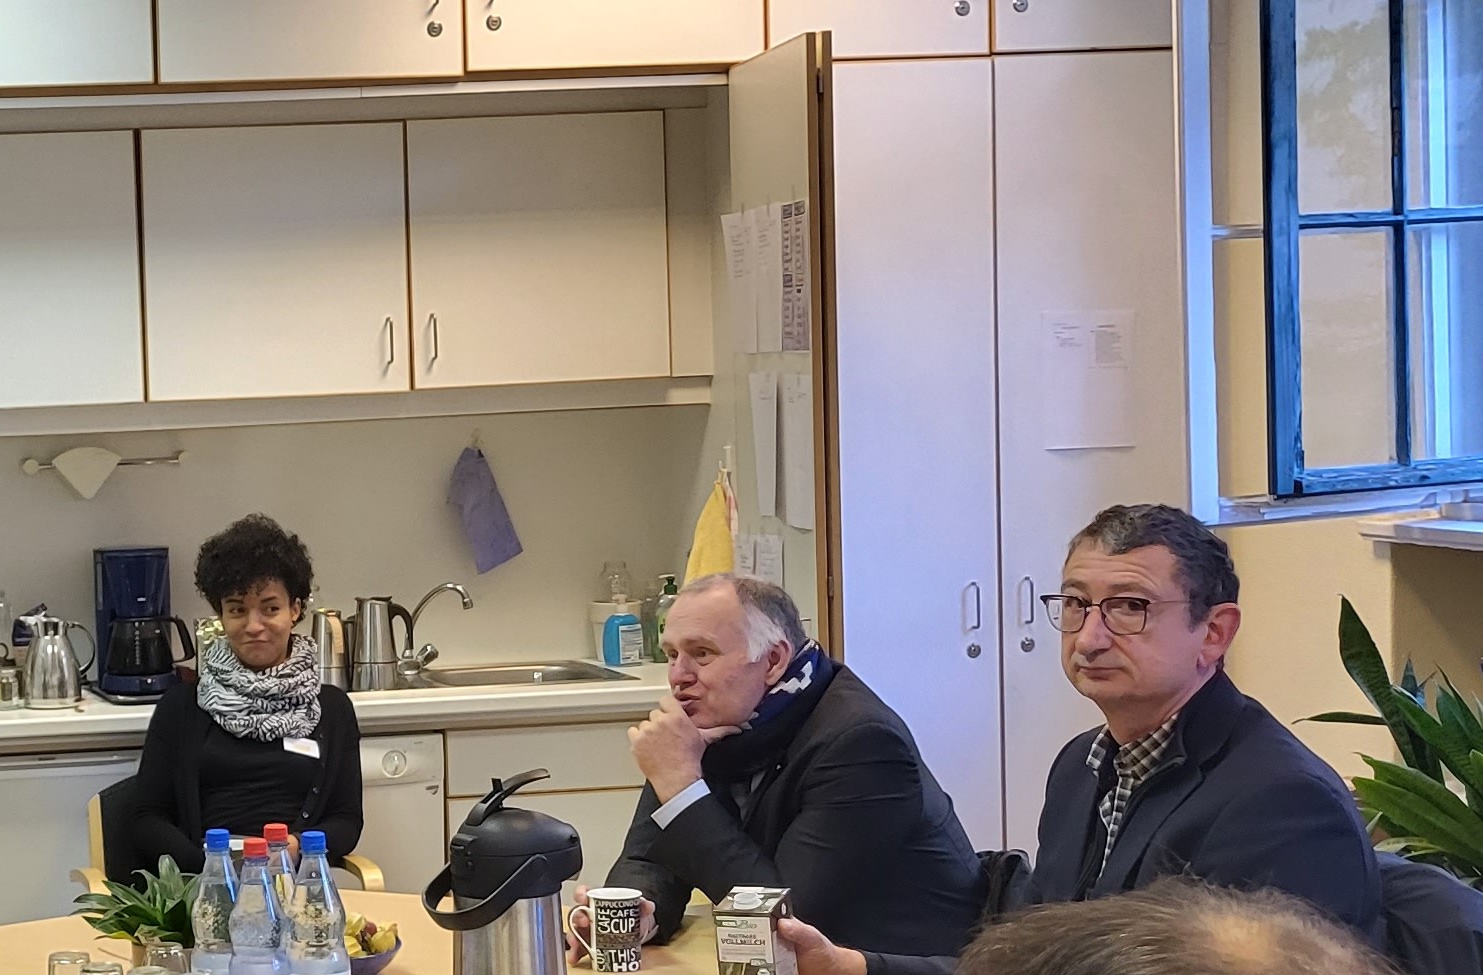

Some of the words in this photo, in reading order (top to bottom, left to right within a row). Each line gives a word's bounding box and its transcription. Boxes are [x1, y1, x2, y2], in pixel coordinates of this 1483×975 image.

[598, 908, 610, 933] CAFE
[610, 909, 635, 918] CAFE
[611, 918, 635, 934] CUP
[597, 949, 605, 972] CUP
[608, 948, 636, 963] THIS
[613, 960, 641, 972] HO
